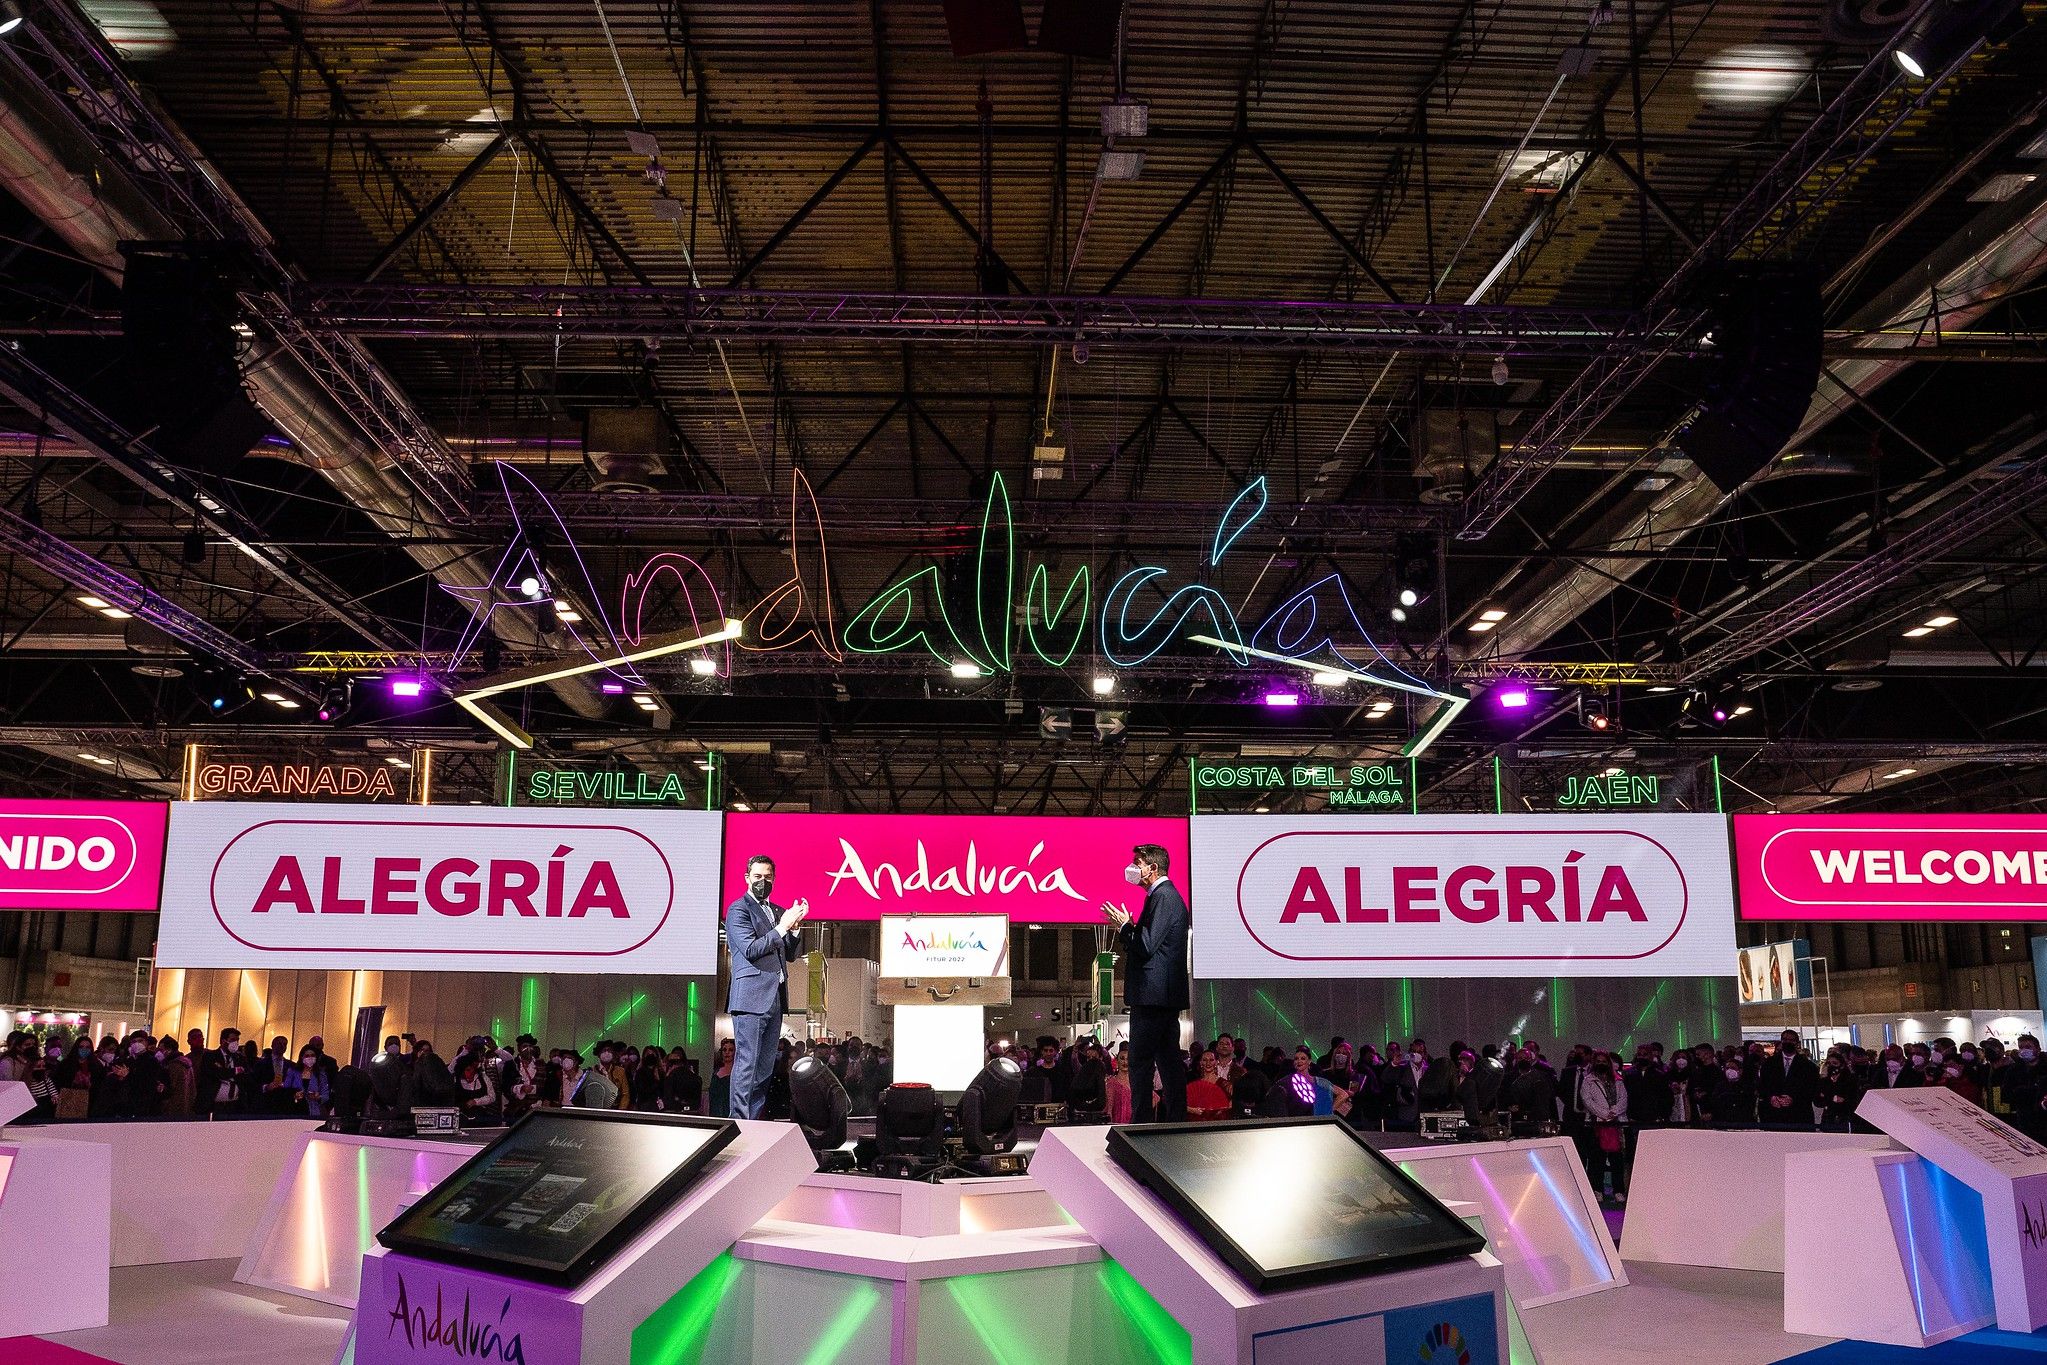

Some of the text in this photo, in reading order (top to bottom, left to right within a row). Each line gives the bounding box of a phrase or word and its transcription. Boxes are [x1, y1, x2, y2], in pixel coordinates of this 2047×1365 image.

[438, 459, 1443, 697] Andalucía
[200, 764, 395, 795] GRANADA
[530, 771, 686, 800] SEVILLA
[1198, 766, 1402, 786] COSTA DEL SOL
[1558, 768, 1658, 805] JAÉN
[1330, 789, 1403, 804] MÁLAGA
[252, 844, 631, 919] ALEGRÍA
[826, 838, 1088, 902] Andalucía
[1279, 850, 1648, 924] ALEGRÍA
[901, 931, 988, 952] Andalucía
[388, 1271, 526, 1365] Andalucía
